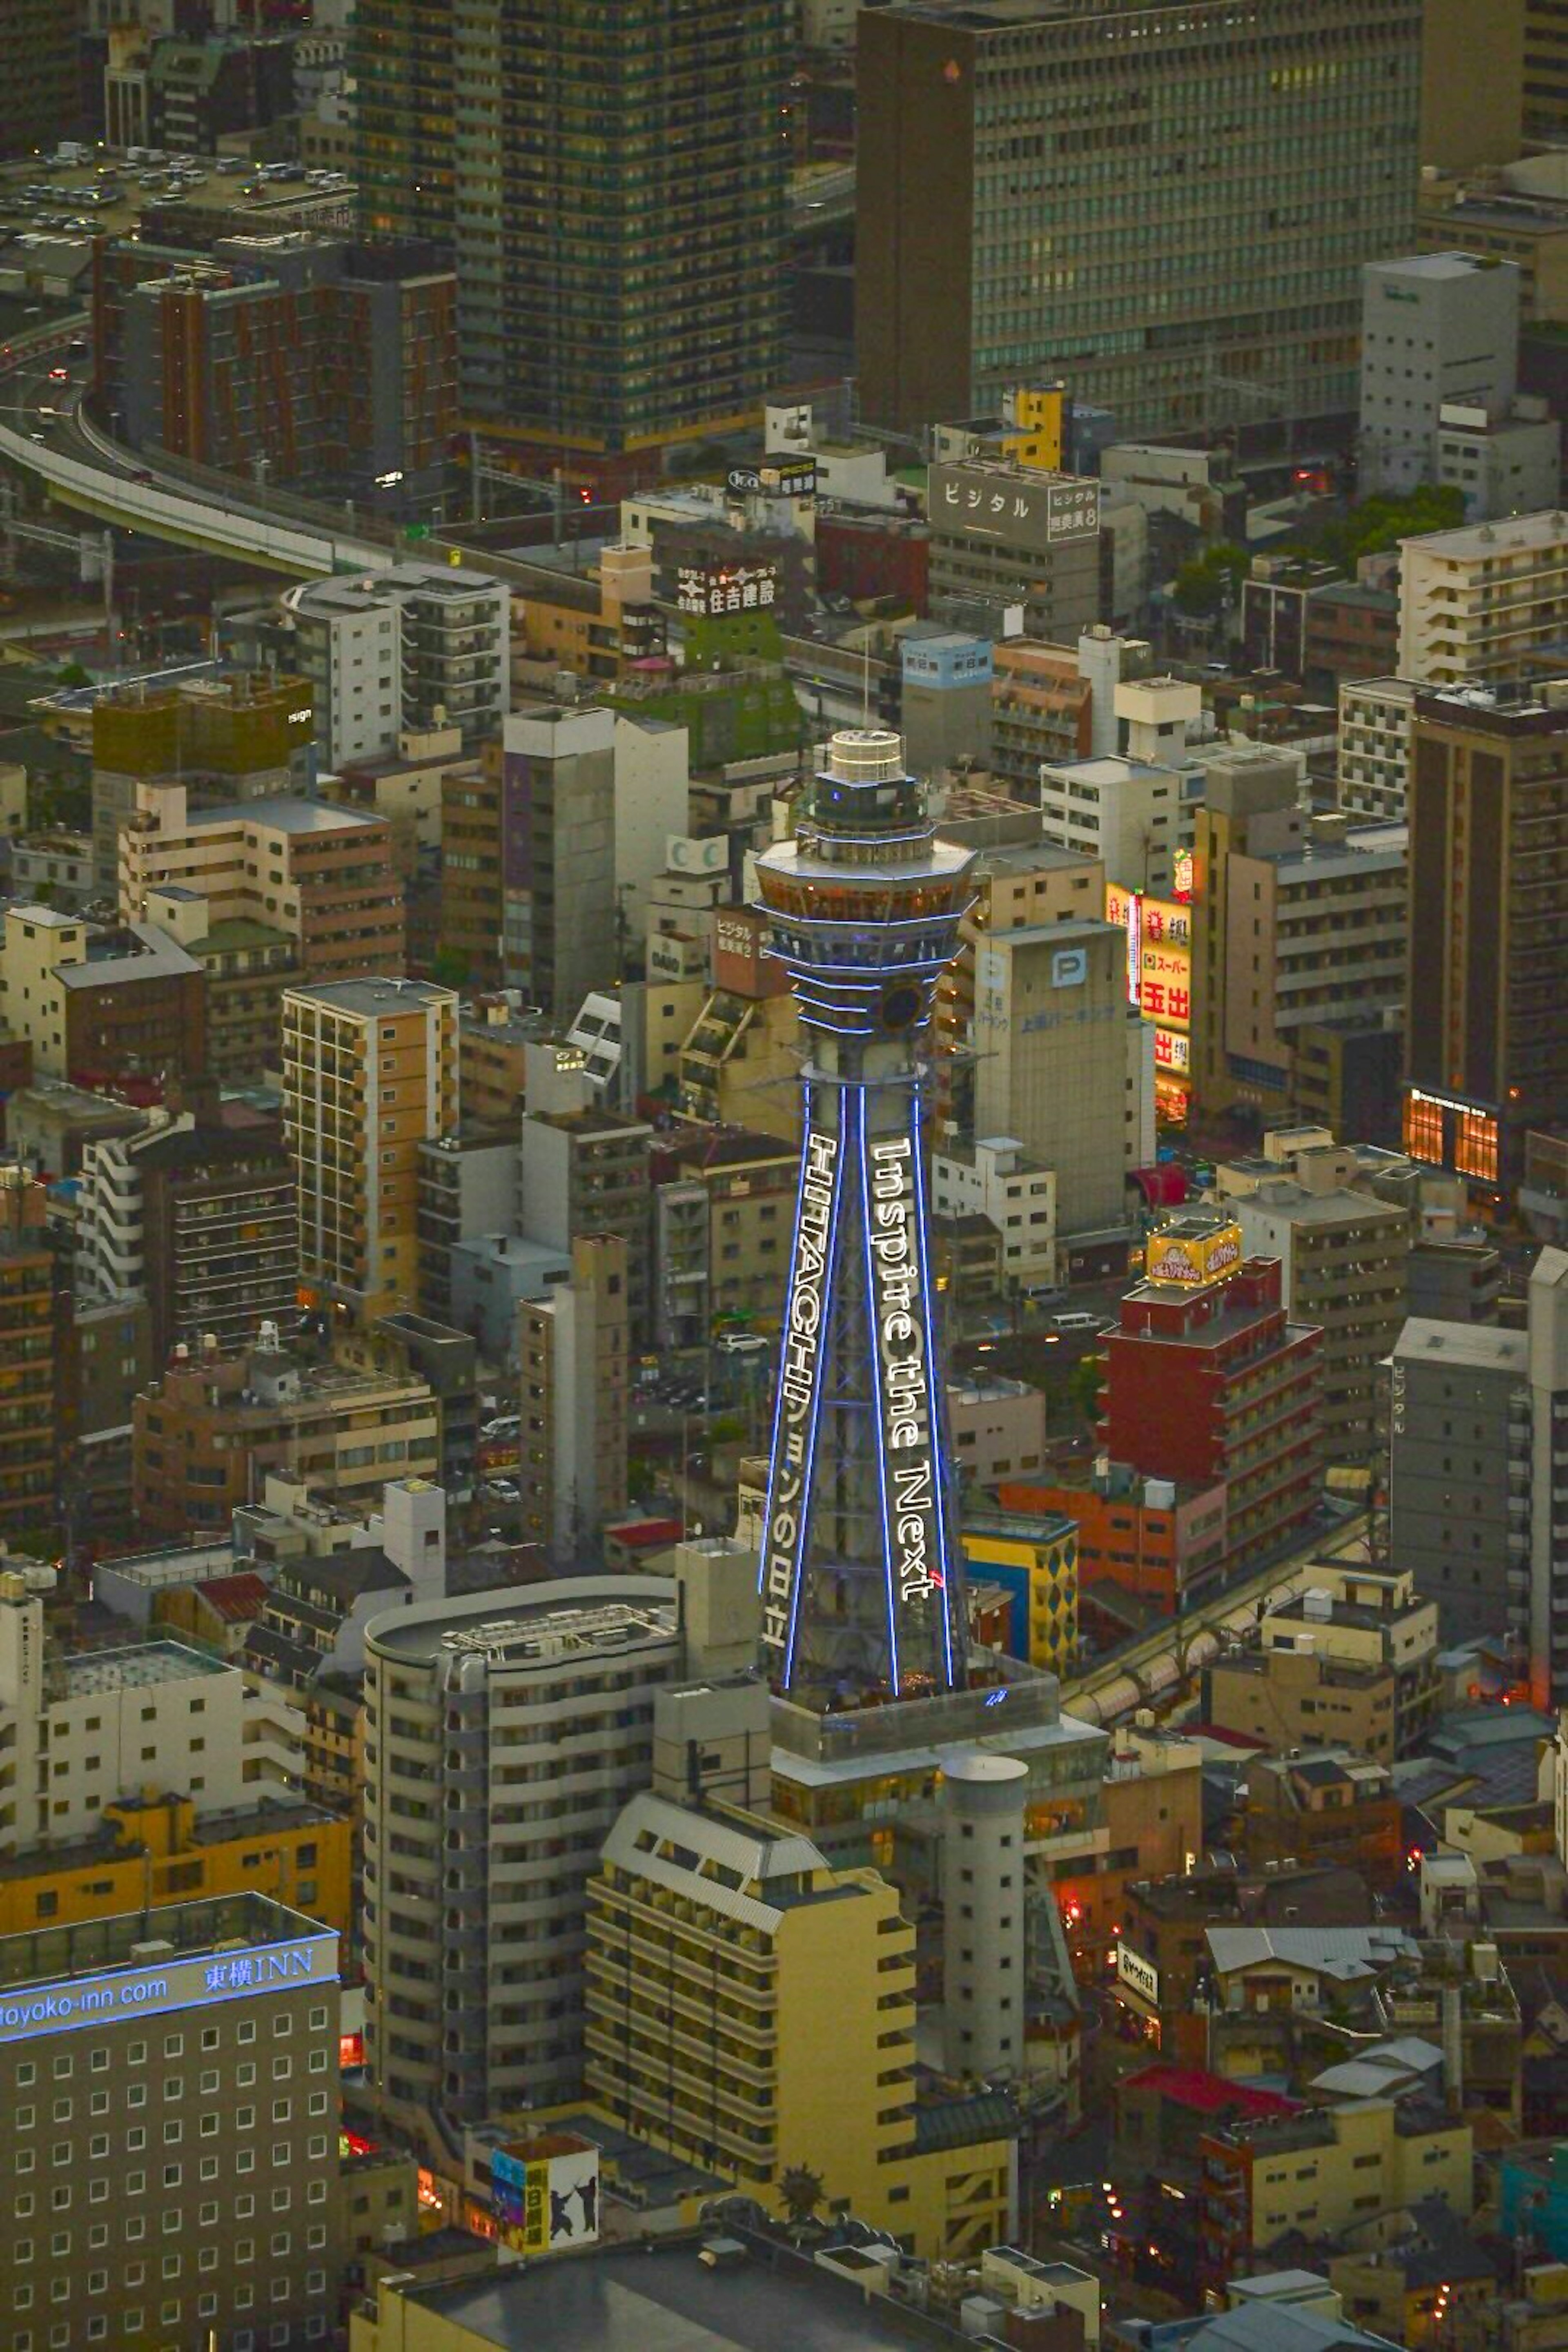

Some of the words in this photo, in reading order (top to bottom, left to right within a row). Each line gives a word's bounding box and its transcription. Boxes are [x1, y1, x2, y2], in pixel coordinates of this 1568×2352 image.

[710, 579, 775, 613] 住吉建設
[1144, 981, 1188, 1019] 玉出
[1157, 957, 1188, 974] スーパー
[782, 1133, 837, 1404] HITACHI
[870, 1137, 919, 1343] Inspire
[887, 1355, 926, 1450] the
[893, 1459, 935, 1602] Next
[204, 1947, 313, 1993] 東横INN
